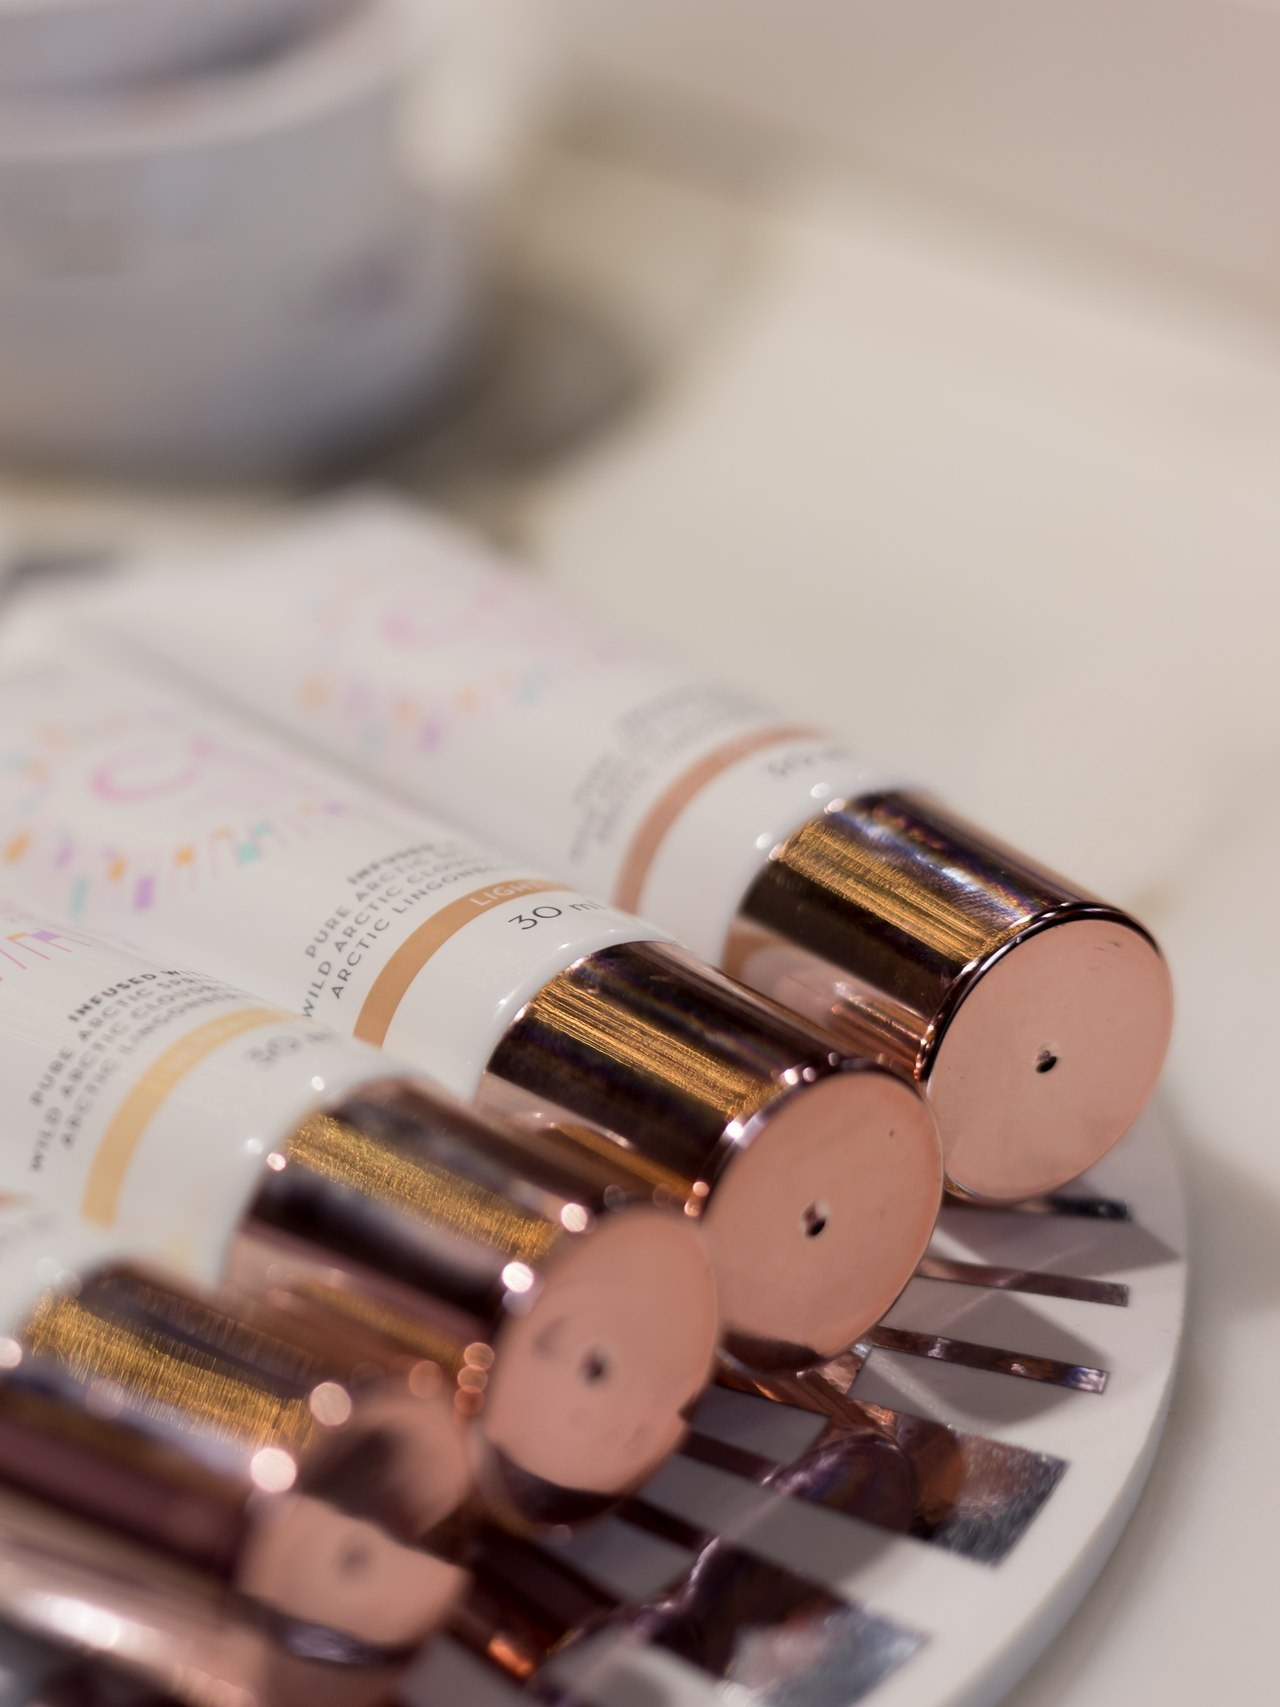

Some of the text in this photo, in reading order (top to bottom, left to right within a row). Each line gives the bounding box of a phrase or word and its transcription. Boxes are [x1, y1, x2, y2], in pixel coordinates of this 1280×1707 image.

[305, 856, 432, 959] PURE ARCTIC
[507, 905, 562, 930] 30
[301, 960, 332, 1018] WILD
[334, 886, 403, 953] ARCTIC
[331, 917, 390, 1000] ARCTIC
[67, 972, 157, 1022] INFUSED
[28, 1045, 73, 1107] PURE
[77, 986, 155, 1042] ARCTIC
[28, 1106, 64, 1173] WILD
